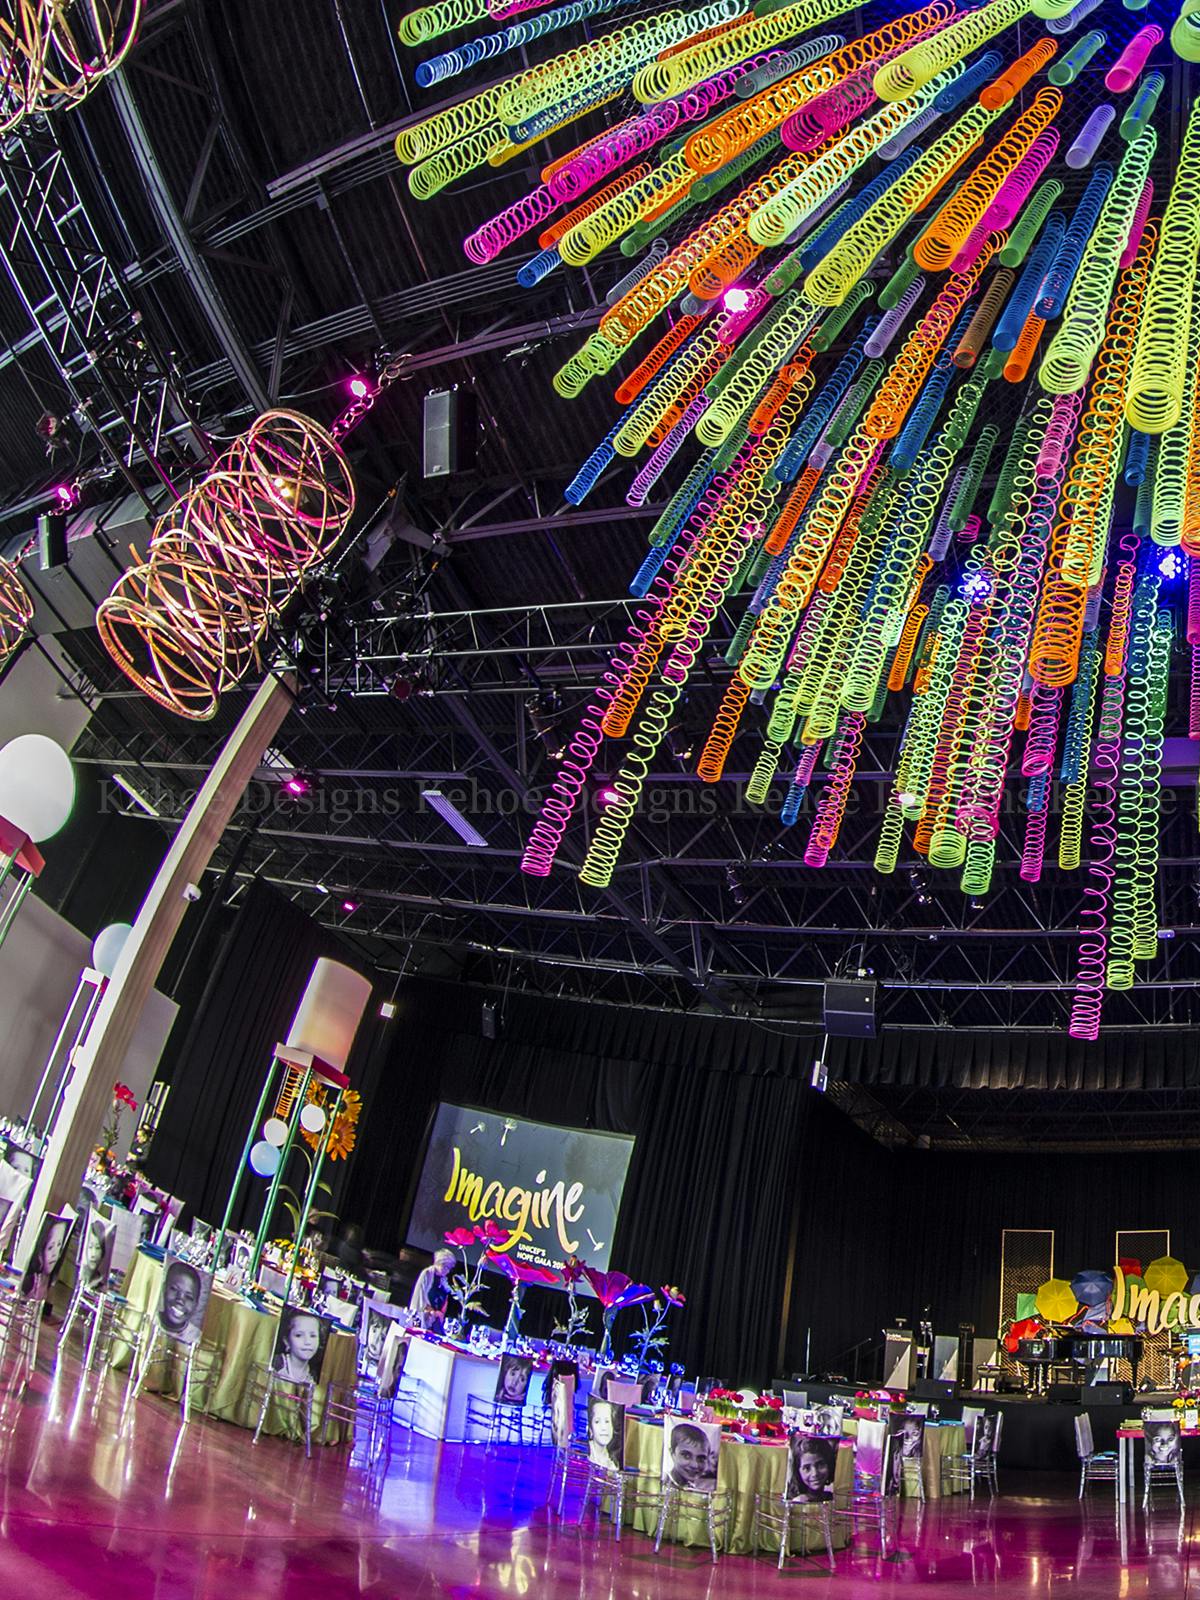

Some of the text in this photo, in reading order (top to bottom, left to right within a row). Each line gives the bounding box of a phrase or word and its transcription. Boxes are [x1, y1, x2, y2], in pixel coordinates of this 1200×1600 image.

[444, 1147, 585, 1253] Imagine
[516, 1251, 534, 1262] HOPE
[533, 1256, 552, 1267] GALA
